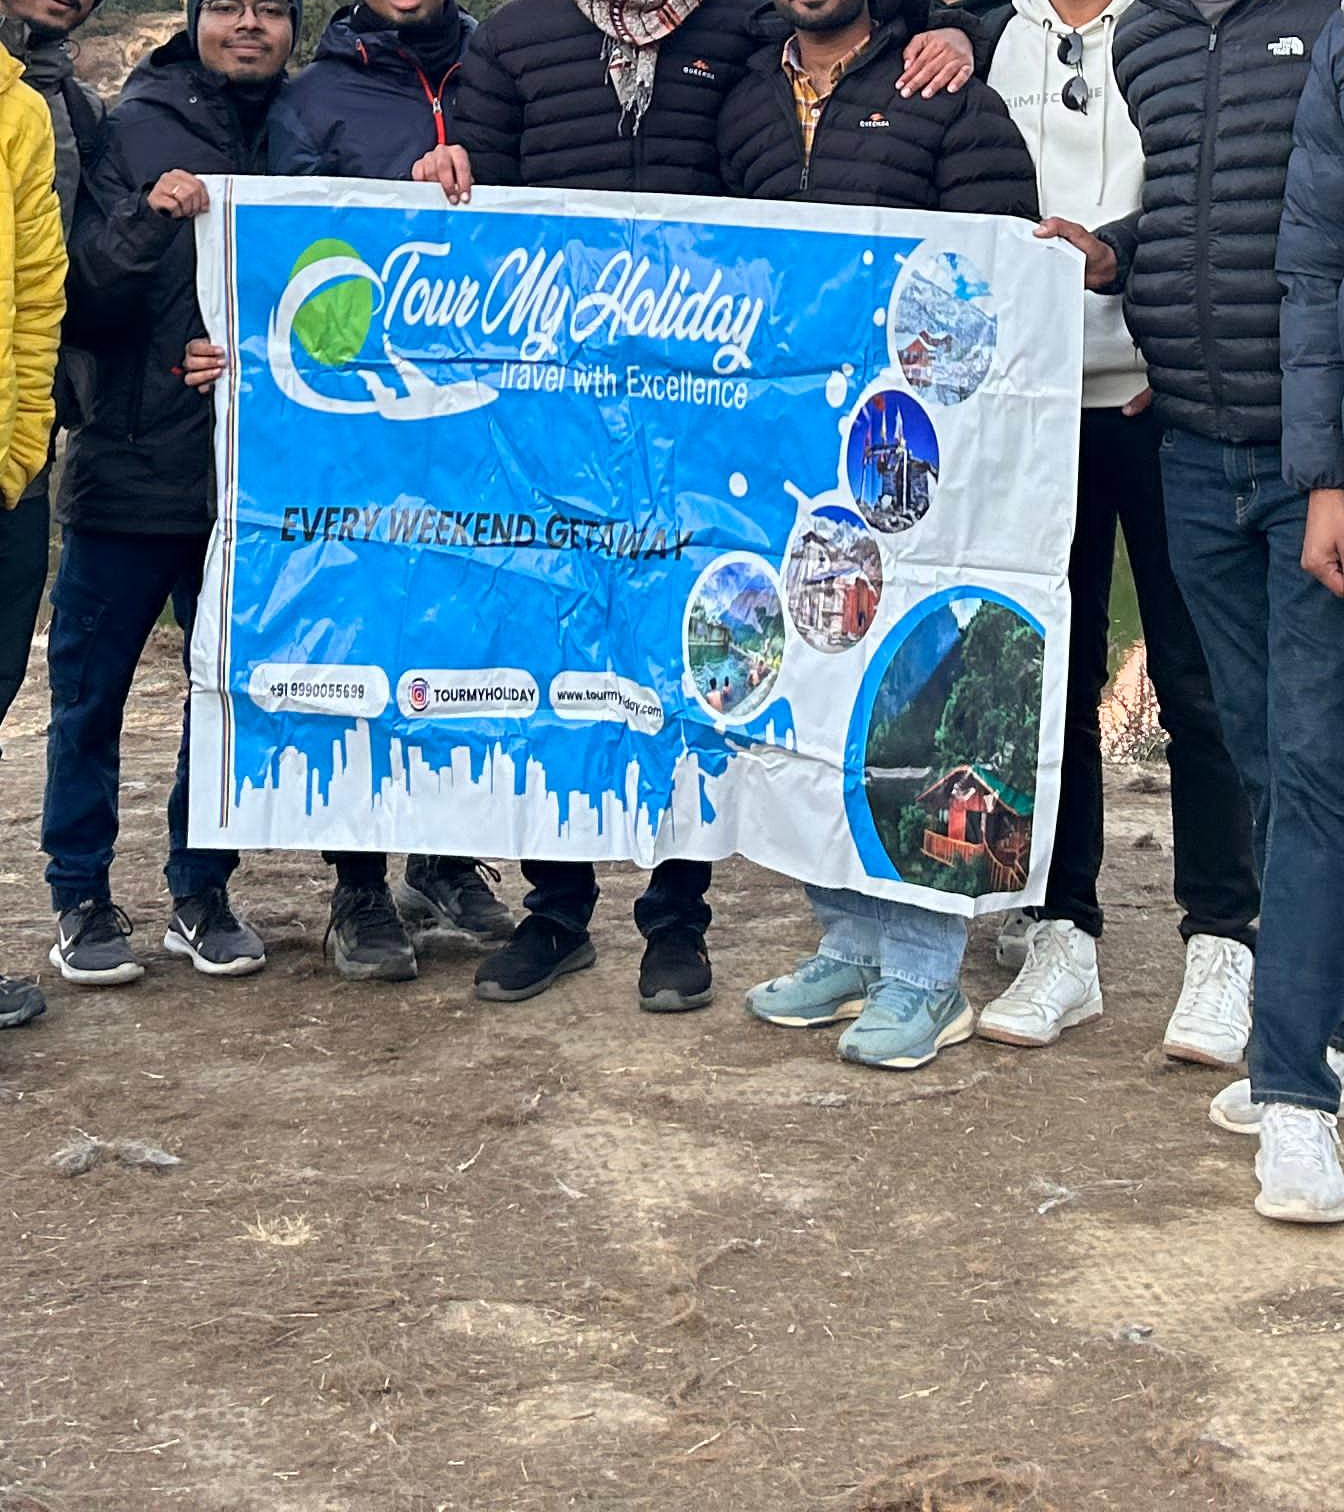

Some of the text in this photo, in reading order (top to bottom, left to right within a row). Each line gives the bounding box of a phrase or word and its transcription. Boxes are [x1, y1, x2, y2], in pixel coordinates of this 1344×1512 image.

[381, 240, 765, 375] Tour My Holiday
[499, 360, 566, 394] Travel
[625, 364, 749, 410] Excellence
[280, 506, 694, 561] EVERY WEEKEND GETAWAY
[433, 686, 536, 703] TOURMYHOLIDAY
